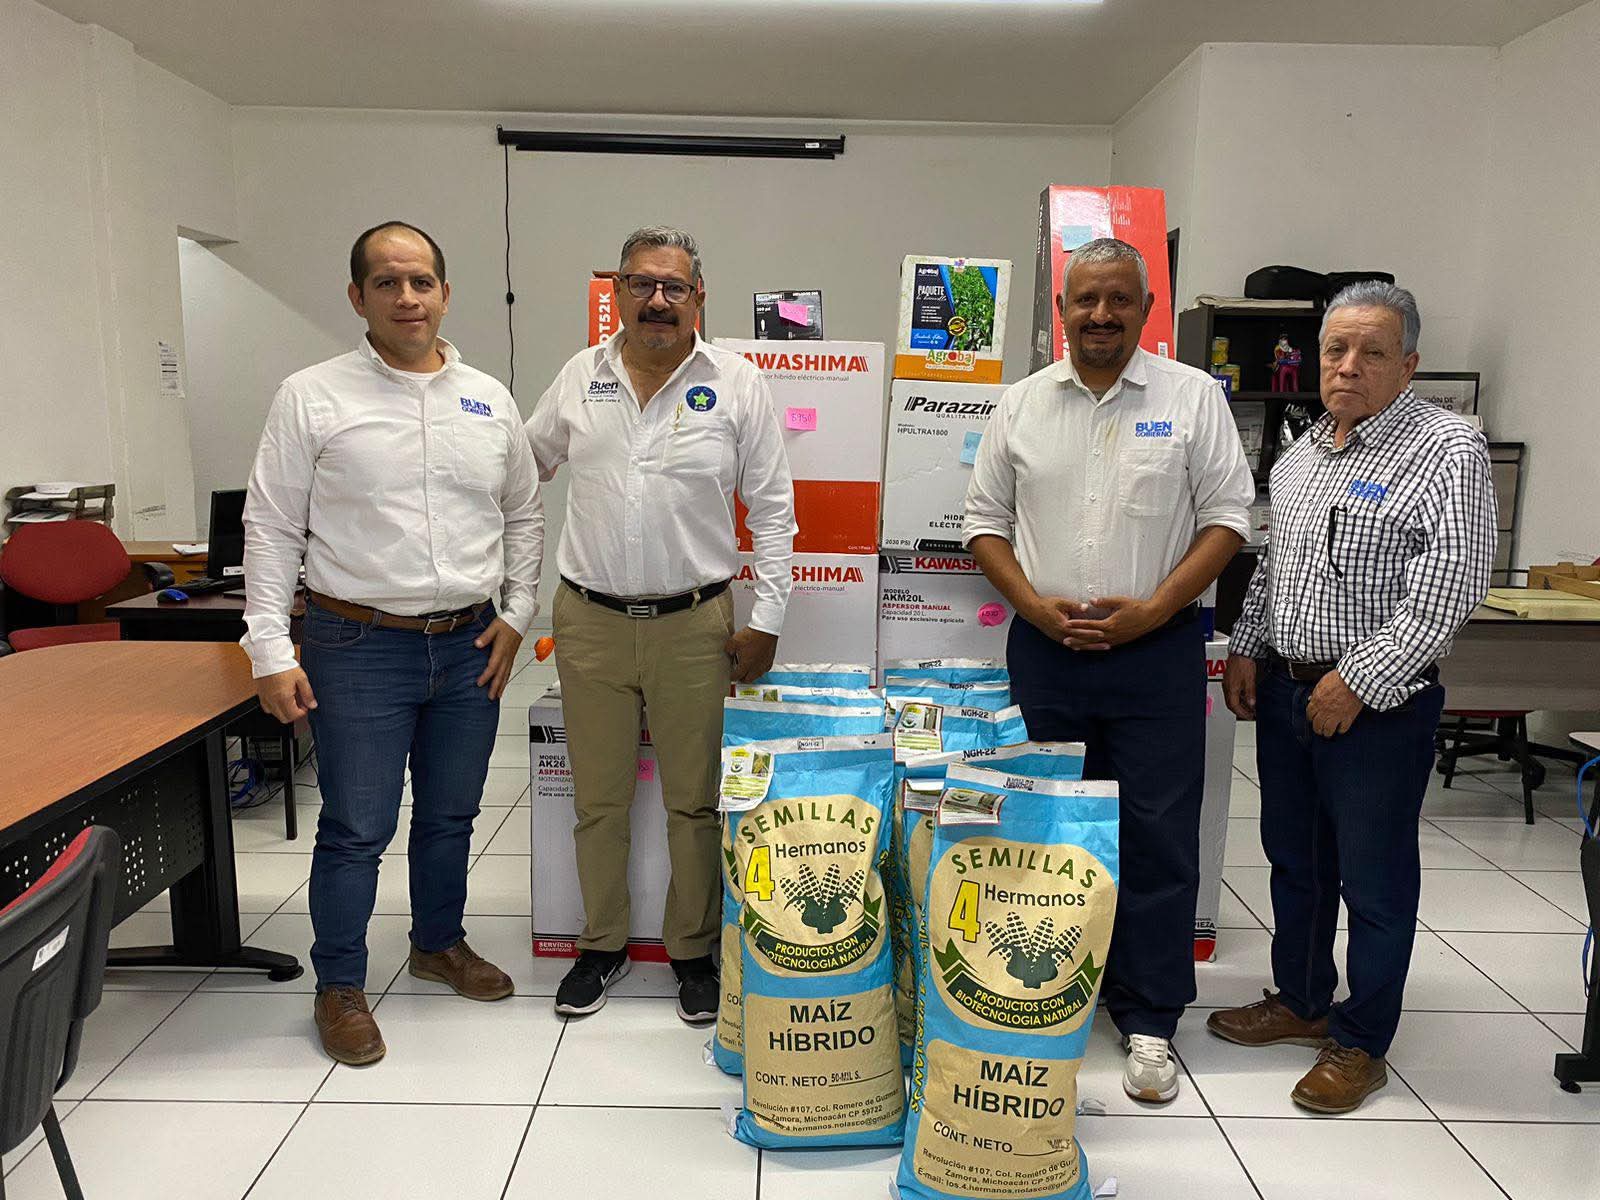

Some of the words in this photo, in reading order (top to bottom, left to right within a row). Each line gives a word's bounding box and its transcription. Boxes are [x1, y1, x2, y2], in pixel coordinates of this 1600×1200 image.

[589, 381, 619, 391] Buen
[460, 397, 492, 413] BUEN
[897, 427, 949, 436] HPULTRA1800
[1135, 421, 1172, 431] BUEN
[882, 594, 925, 602] AKM20L
[960, 709, 989, 719] NGH-22
[963, 748, 997, 760] NGH-22
[741, 802, 875, 844] SEMILLAS
[744, 845, 776, 901] 4
[775, 840, 867, 858] Hermanos
[952, 848, 1097, 888] SEMILLAS
[948, 879, 982, 943] 4
[984, 883, 1086, 907] Hermanos
[775, 942, 835, 963] PRODUCTOS
[835, 936, 859, 952] CON
[839, 937, 875, 965] NATURAL
[789, 1000, 852, 1023] MAÍZ
[955, 989, 1040, 1026] BIOTECNOLOGIA
[1043, 999, 1083, 1024] NATURAL
[975, 989, 1038, 1012] PRODUCTOS
[1041, 996, 1065, 1011] CON
[769, 1025, 876, 1051] HÍBRIDO
[755, 1071, 788, 1087] CONT.
[792, 1076, 828, 1087] NETO
[980, 1060, 1049, 1087] MAÍZ
[752, 1098, 789, 1113] Revolución
[790, 1105, 814, 1114] #107,
[815, 1105, 831, 1113] Col.
[832, 1101, 863, 1111] Romero
[953, 1084, 1065, 1119] HÍBRIDO
[771, 1114, 802, 1124] Zamora,
[804, 1112, 847, 1122] Michoacán
[848, 1110, 860, 1118] CP
[862, 1105, 883, 1116] 59722
[933, 1120, 969, 1146] CONT.
[973, 1137, 1013, 1153] NETO
[922, 1148, 967, 1171] Revolución
[968, 1165, 993, 1177] #107,
[995, 1170, 1013, 1178] Col.
[1015, 1167, 1047, 1179] Romero
[1048, 1163, 1058, 1172] de
[917, 1167, 944, 1185] E-mail:
[944, 1168, 980, 1184] Zamora,
[981, 1176, 1029, 1187] Michoacán
